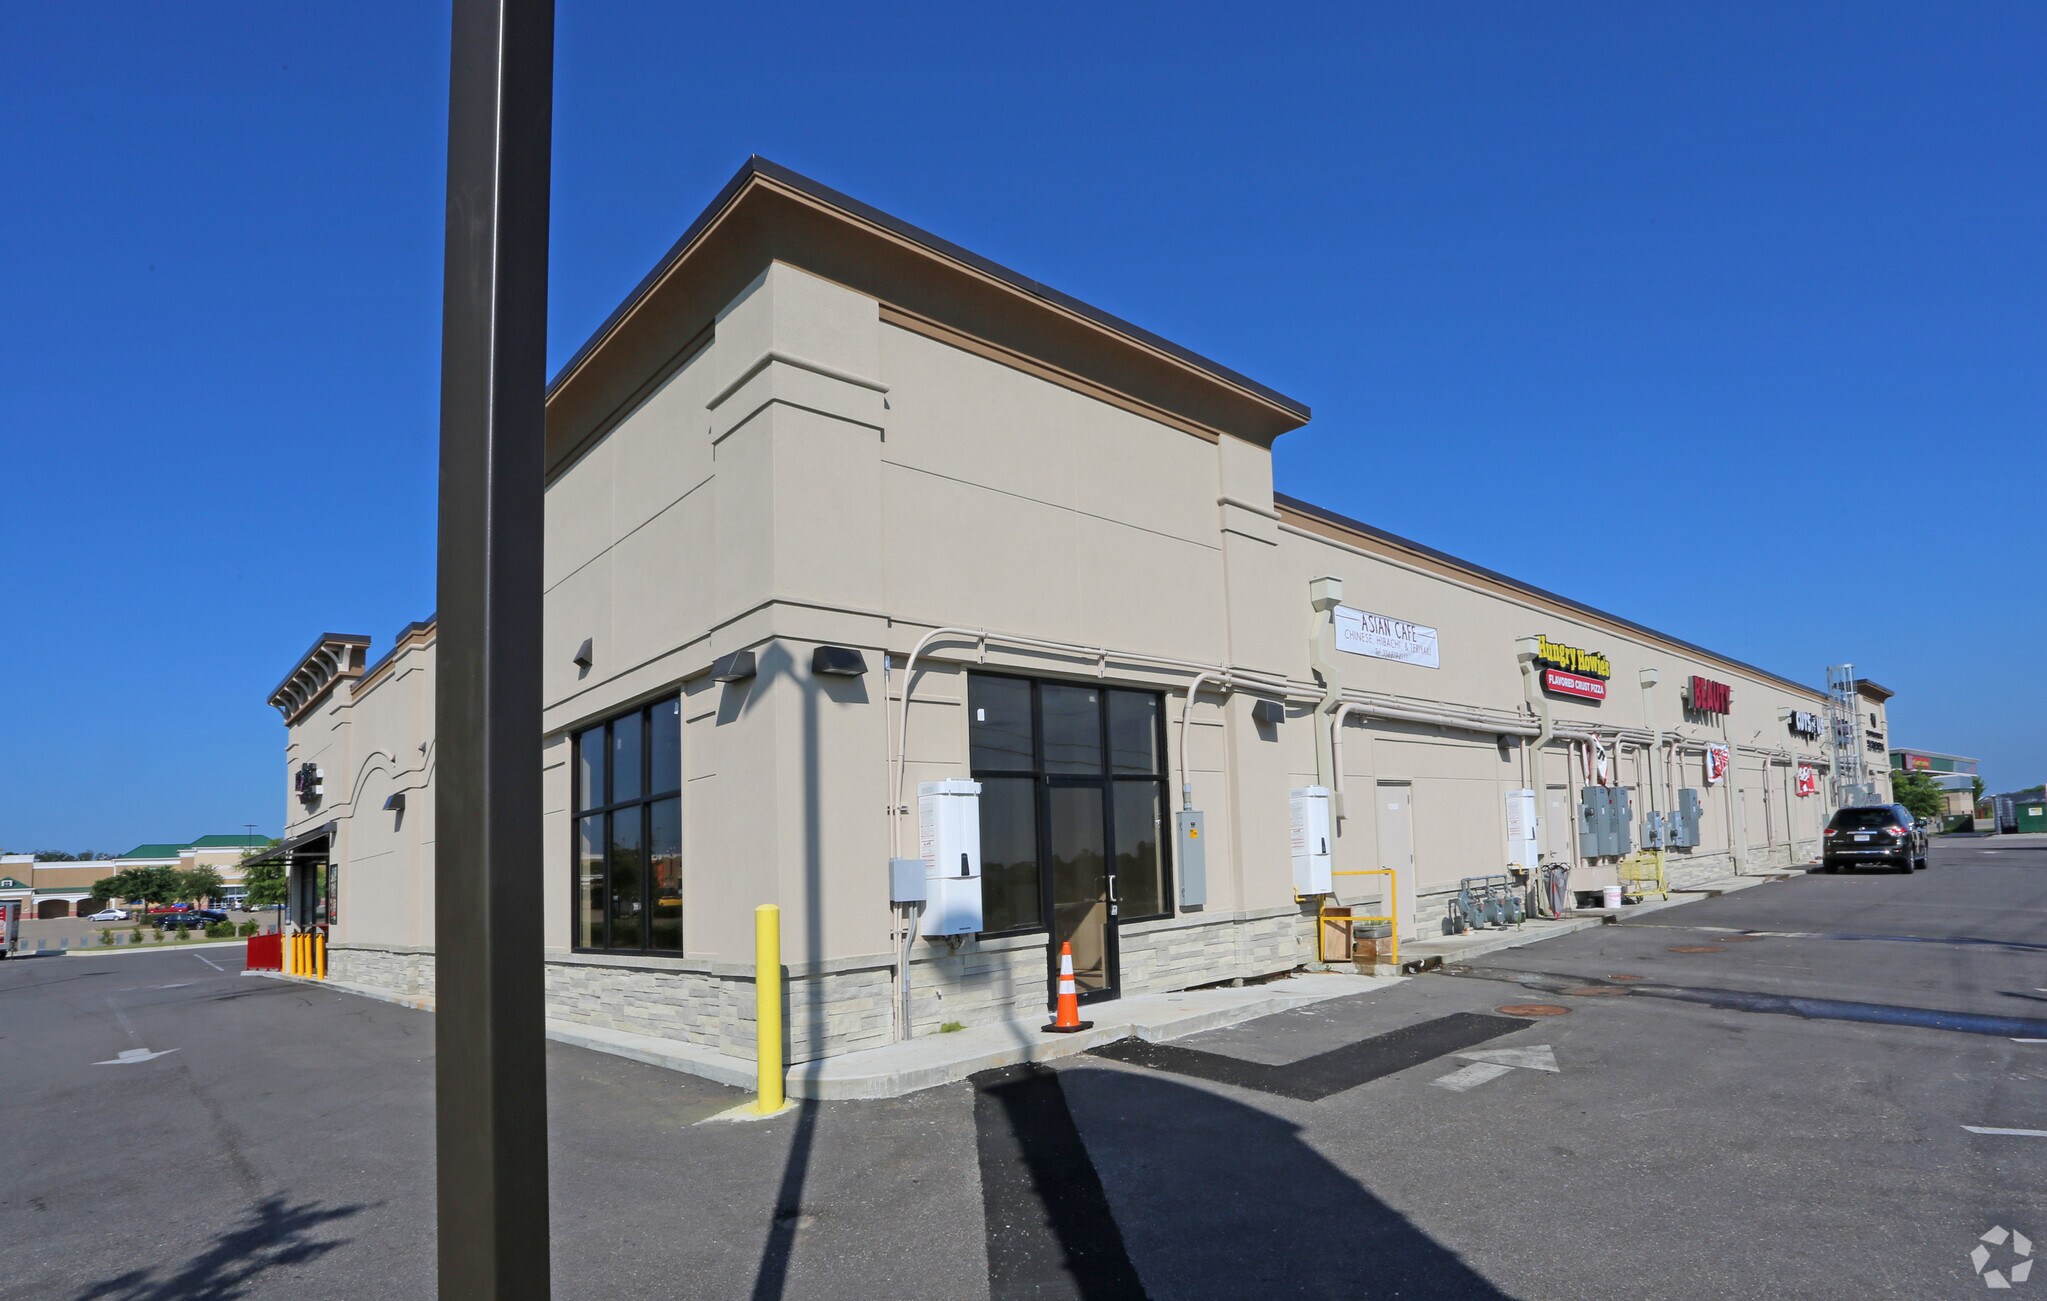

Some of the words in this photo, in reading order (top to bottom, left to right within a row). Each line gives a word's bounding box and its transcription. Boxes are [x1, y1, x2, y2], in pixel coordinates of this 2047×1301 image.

[1361, 614, 1391, 637] ASIAN
[1394, 621, 1417, 643] CAFE
[1410, 643, 1432, 656] TERIYAKI
[1538, 635, 1576, 671] Hungry
[1577, 650, 1610, 678] Howie's
[1548, 674, 1575, 689] FLAVORED
[1575, 680, 1590, 692] CRUST
[1590, 683, 1605, 695] PIZZA
[1693, 675, 1731, 715] BEAUTY
